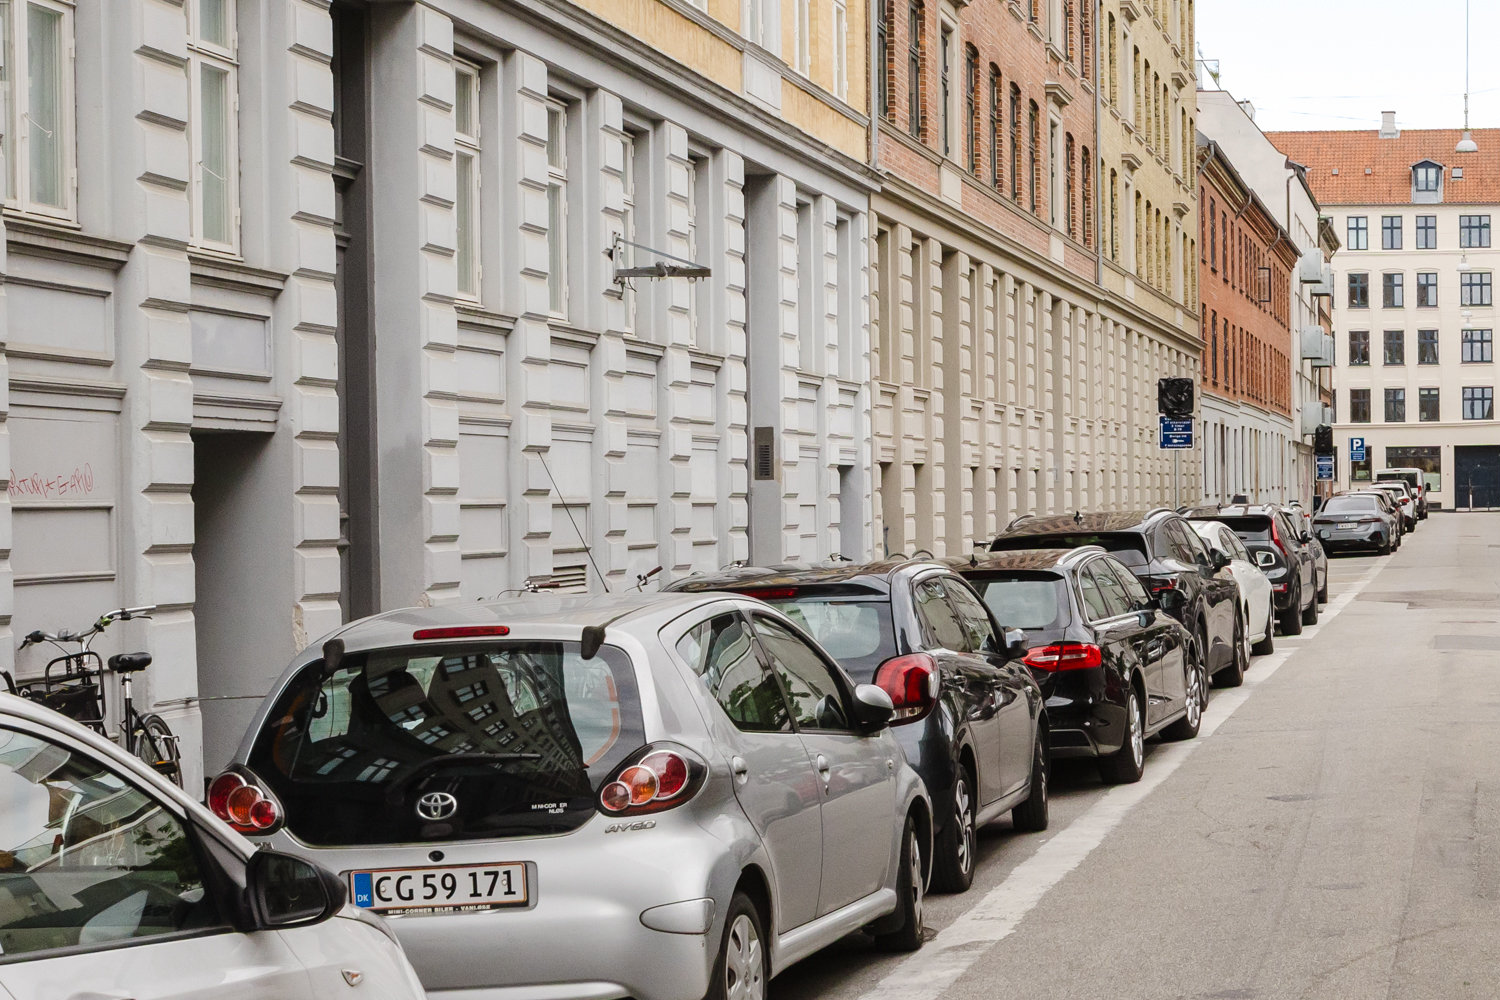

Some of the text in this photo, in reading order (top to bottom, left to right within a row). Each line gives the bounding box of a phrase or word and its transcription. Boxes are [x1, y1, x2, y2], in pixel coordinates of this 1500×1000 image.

[1353, 439, 1362, 451] P
[605, 820, 657, 833] AYGO
[357, 870, 516, 903] DK CG 59 171
